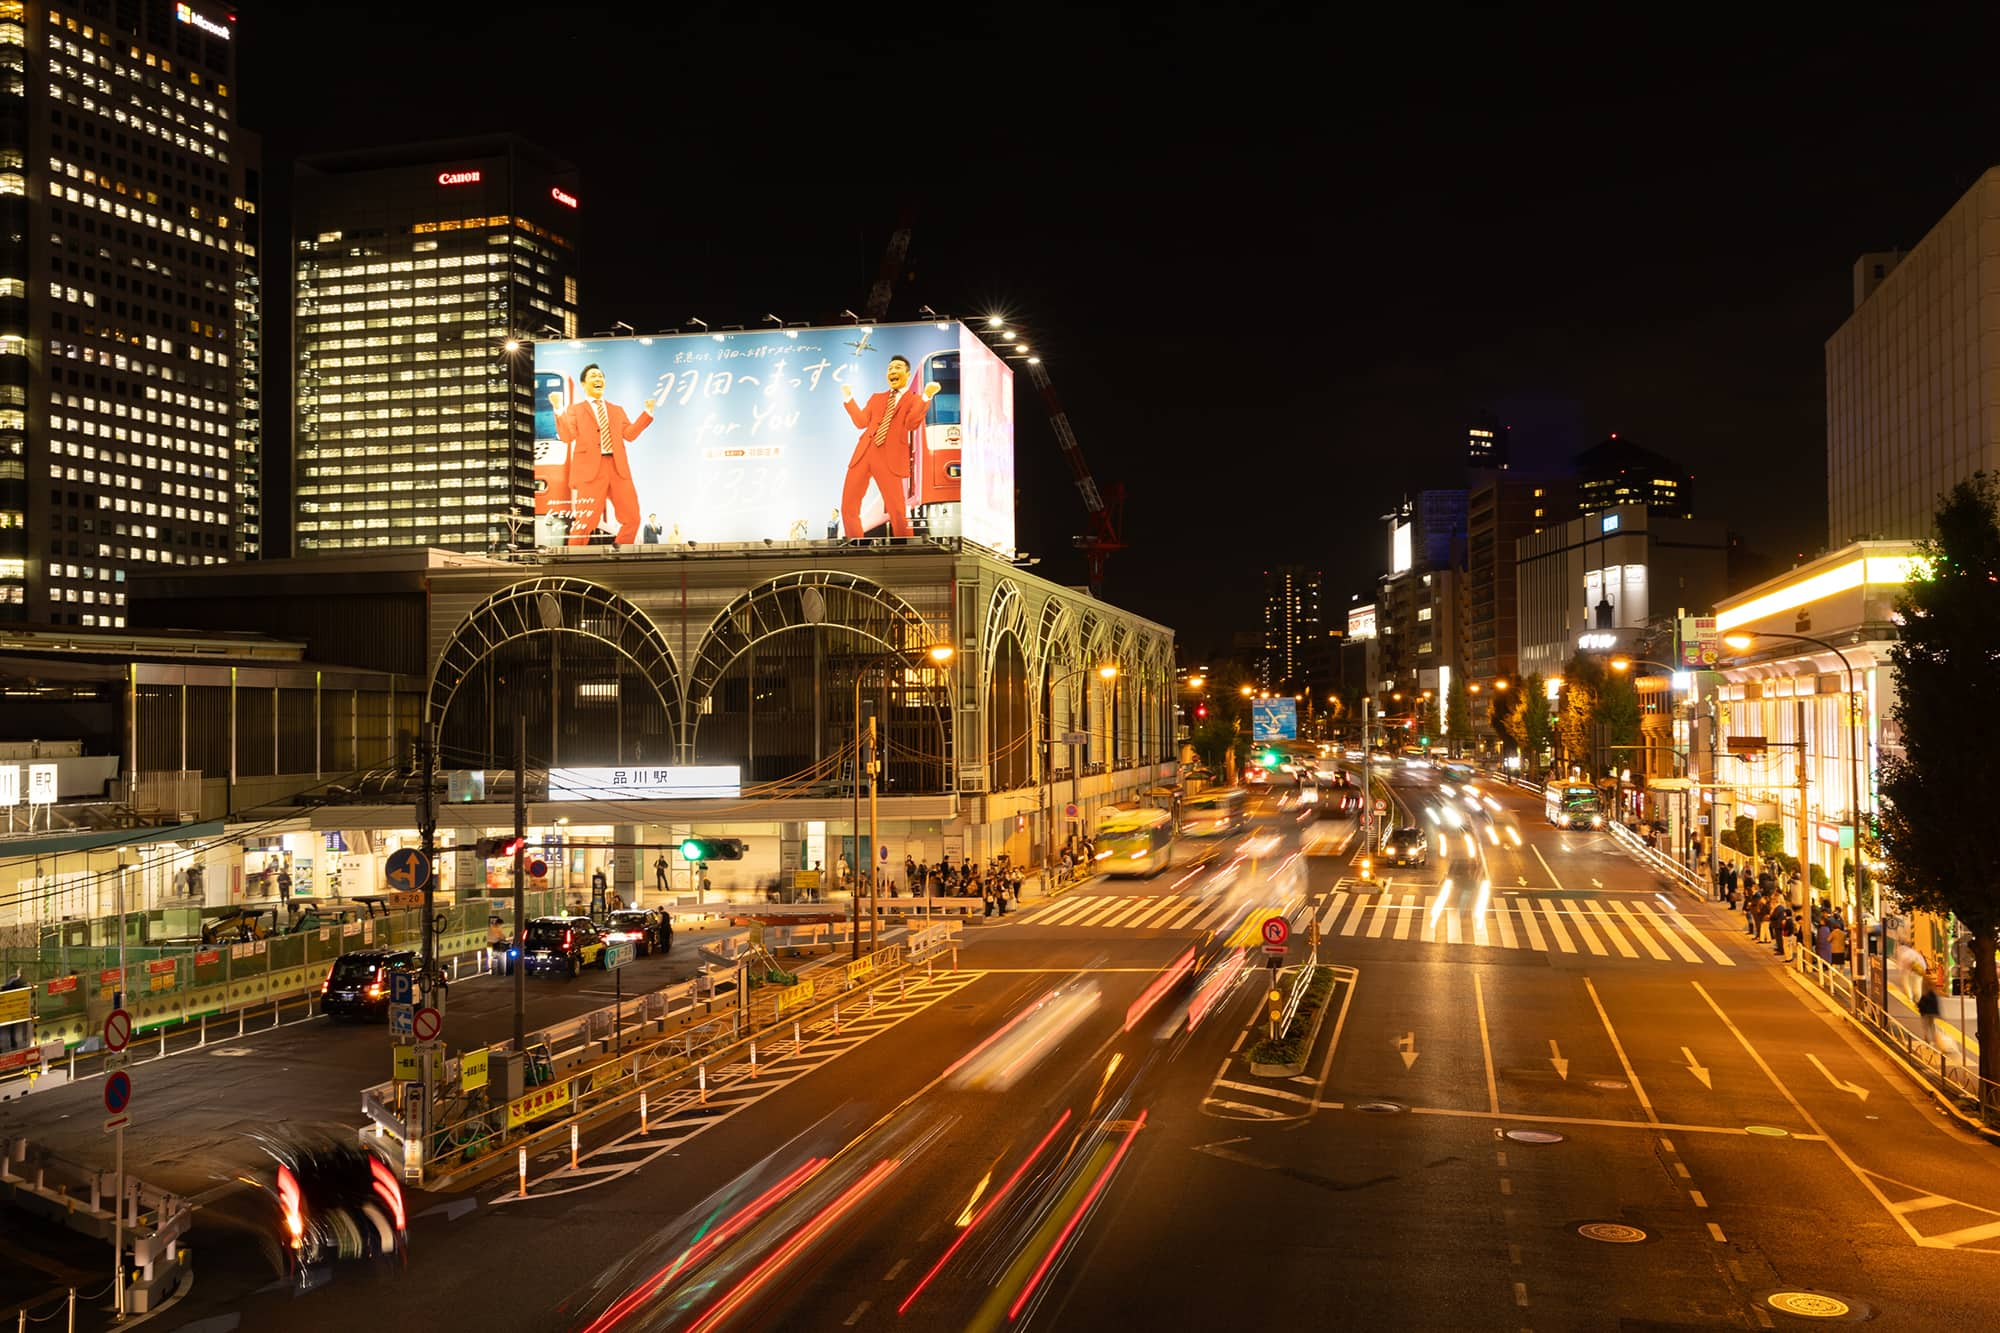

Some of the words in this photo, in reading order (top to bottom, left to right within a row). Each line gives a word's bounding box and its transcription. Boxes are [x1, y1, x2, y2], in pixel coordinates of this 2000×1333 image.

[191, 12, 230, 40] Microsoft
[438, 171, 480, 184] Canon
[552, 188, 577, 208] Canon
[653, 357, 859, 408] 羽田へまっすぐ
[752, 400, 800, 436] You
[613, 771, 668, 785] 品川駅
[394, 894, 419, 903] 8-20
[396, 975, 409, 1001] P
